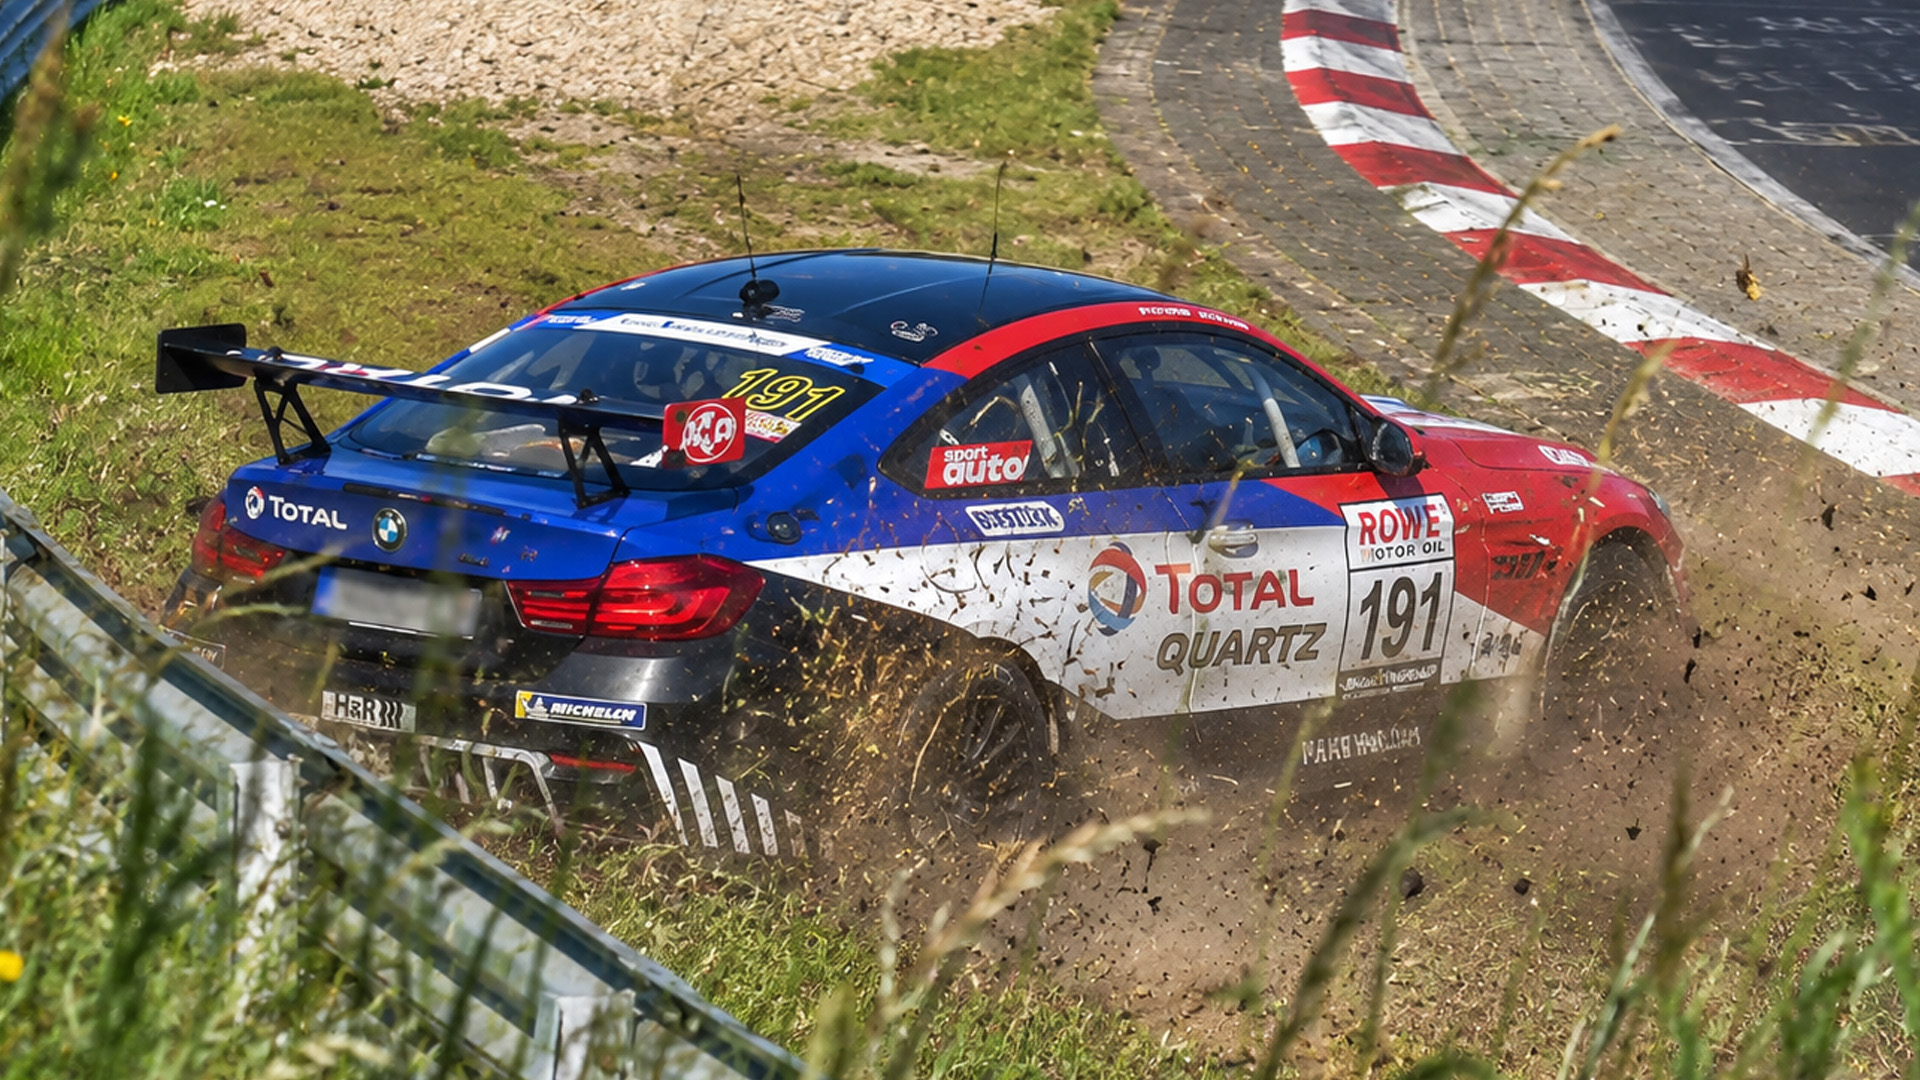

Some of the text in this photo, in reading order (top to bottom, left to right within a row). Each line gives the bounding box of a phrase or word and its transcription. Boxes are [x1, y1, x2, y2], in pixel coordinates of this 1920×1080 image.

[721, 368, 846, 422] 191
[943, 446, 989, 463] sport
[943, 454, 1023, 486] auto
[268, 494, 348, 530] TOTAL
[1358, 504, 1440, 546] ROWE
[1422, 541, 1445, 554] OIL
[1154, 563, 1315, 614] TOTAL
[1359, 571, 1443, 660] 191
[1157, 622, 1328, 676] QUARTZ
